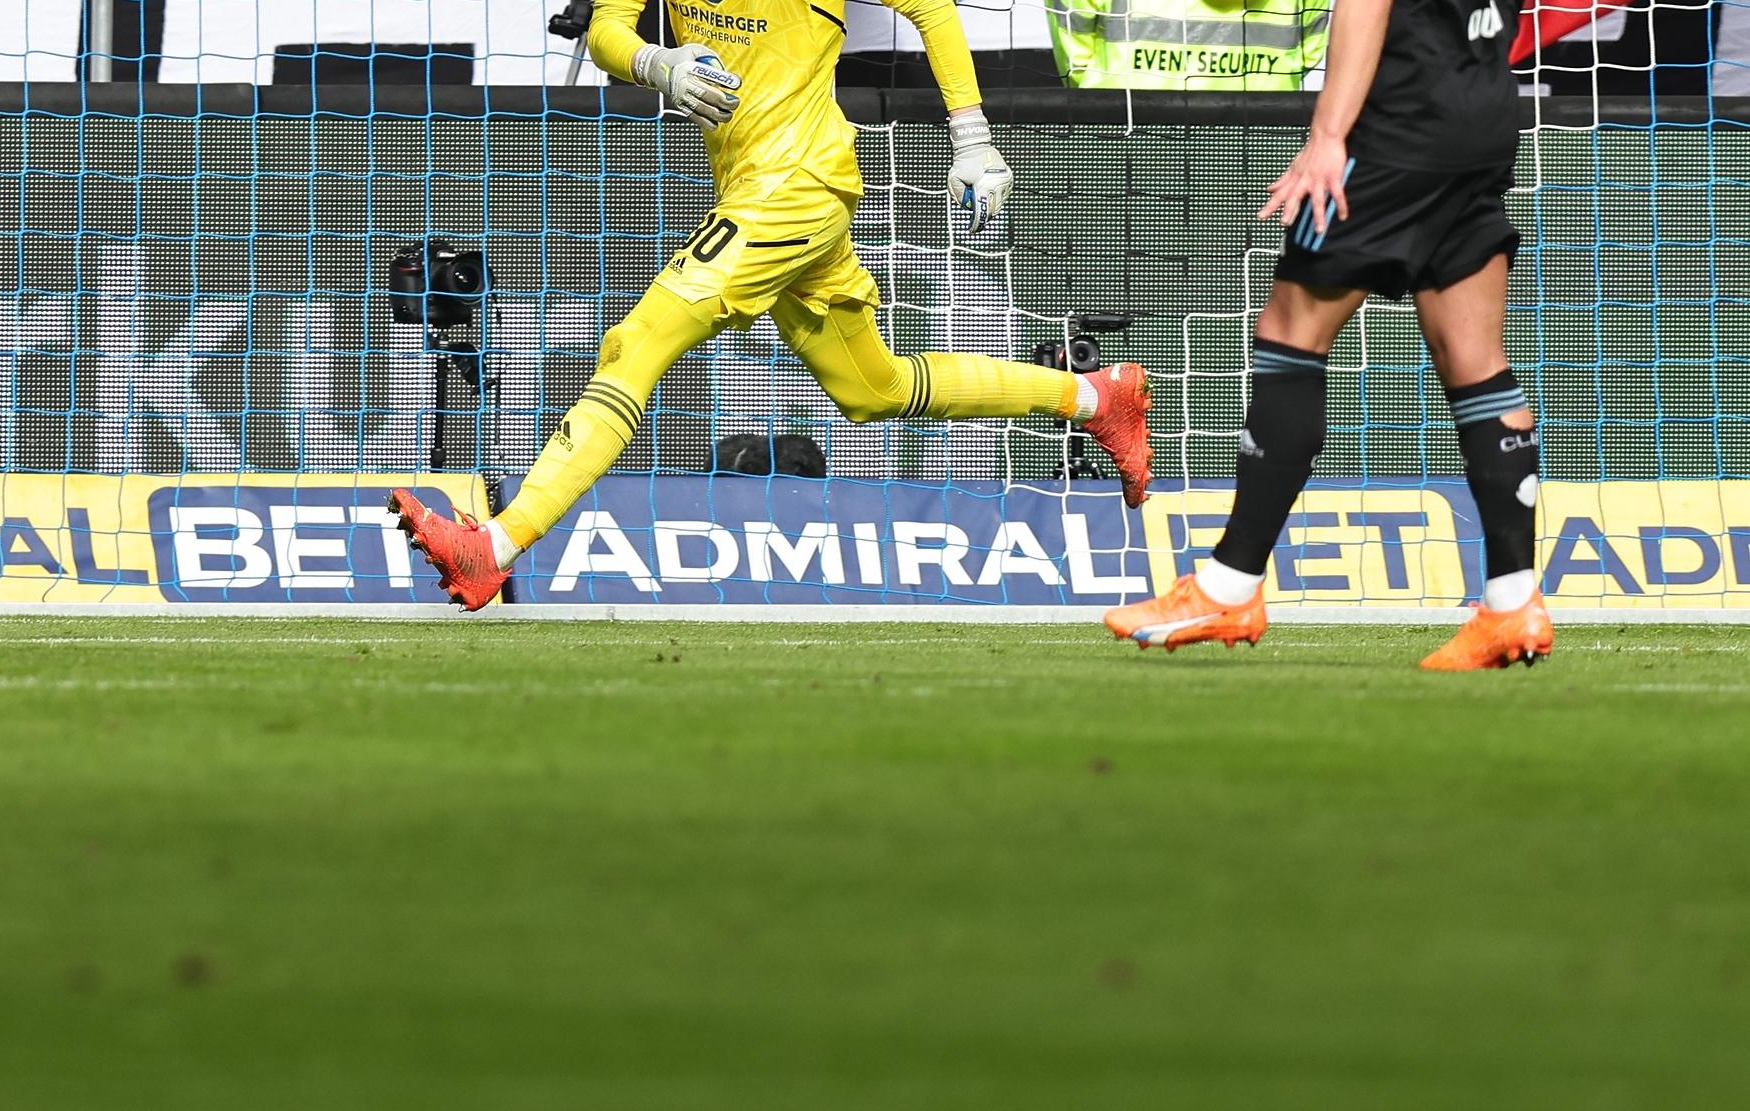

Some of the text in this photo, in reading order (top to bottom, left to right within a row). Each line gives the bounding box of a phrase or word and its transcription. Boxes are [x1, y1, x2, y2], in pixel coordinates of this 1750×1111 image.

[692, 65, 734, 86] reusch
[1134, 48, 1279, 76] EVENT SECURITY
[171, 504, 420, 590] BET
[547, 509, 1149, 595] ADMIRAL
